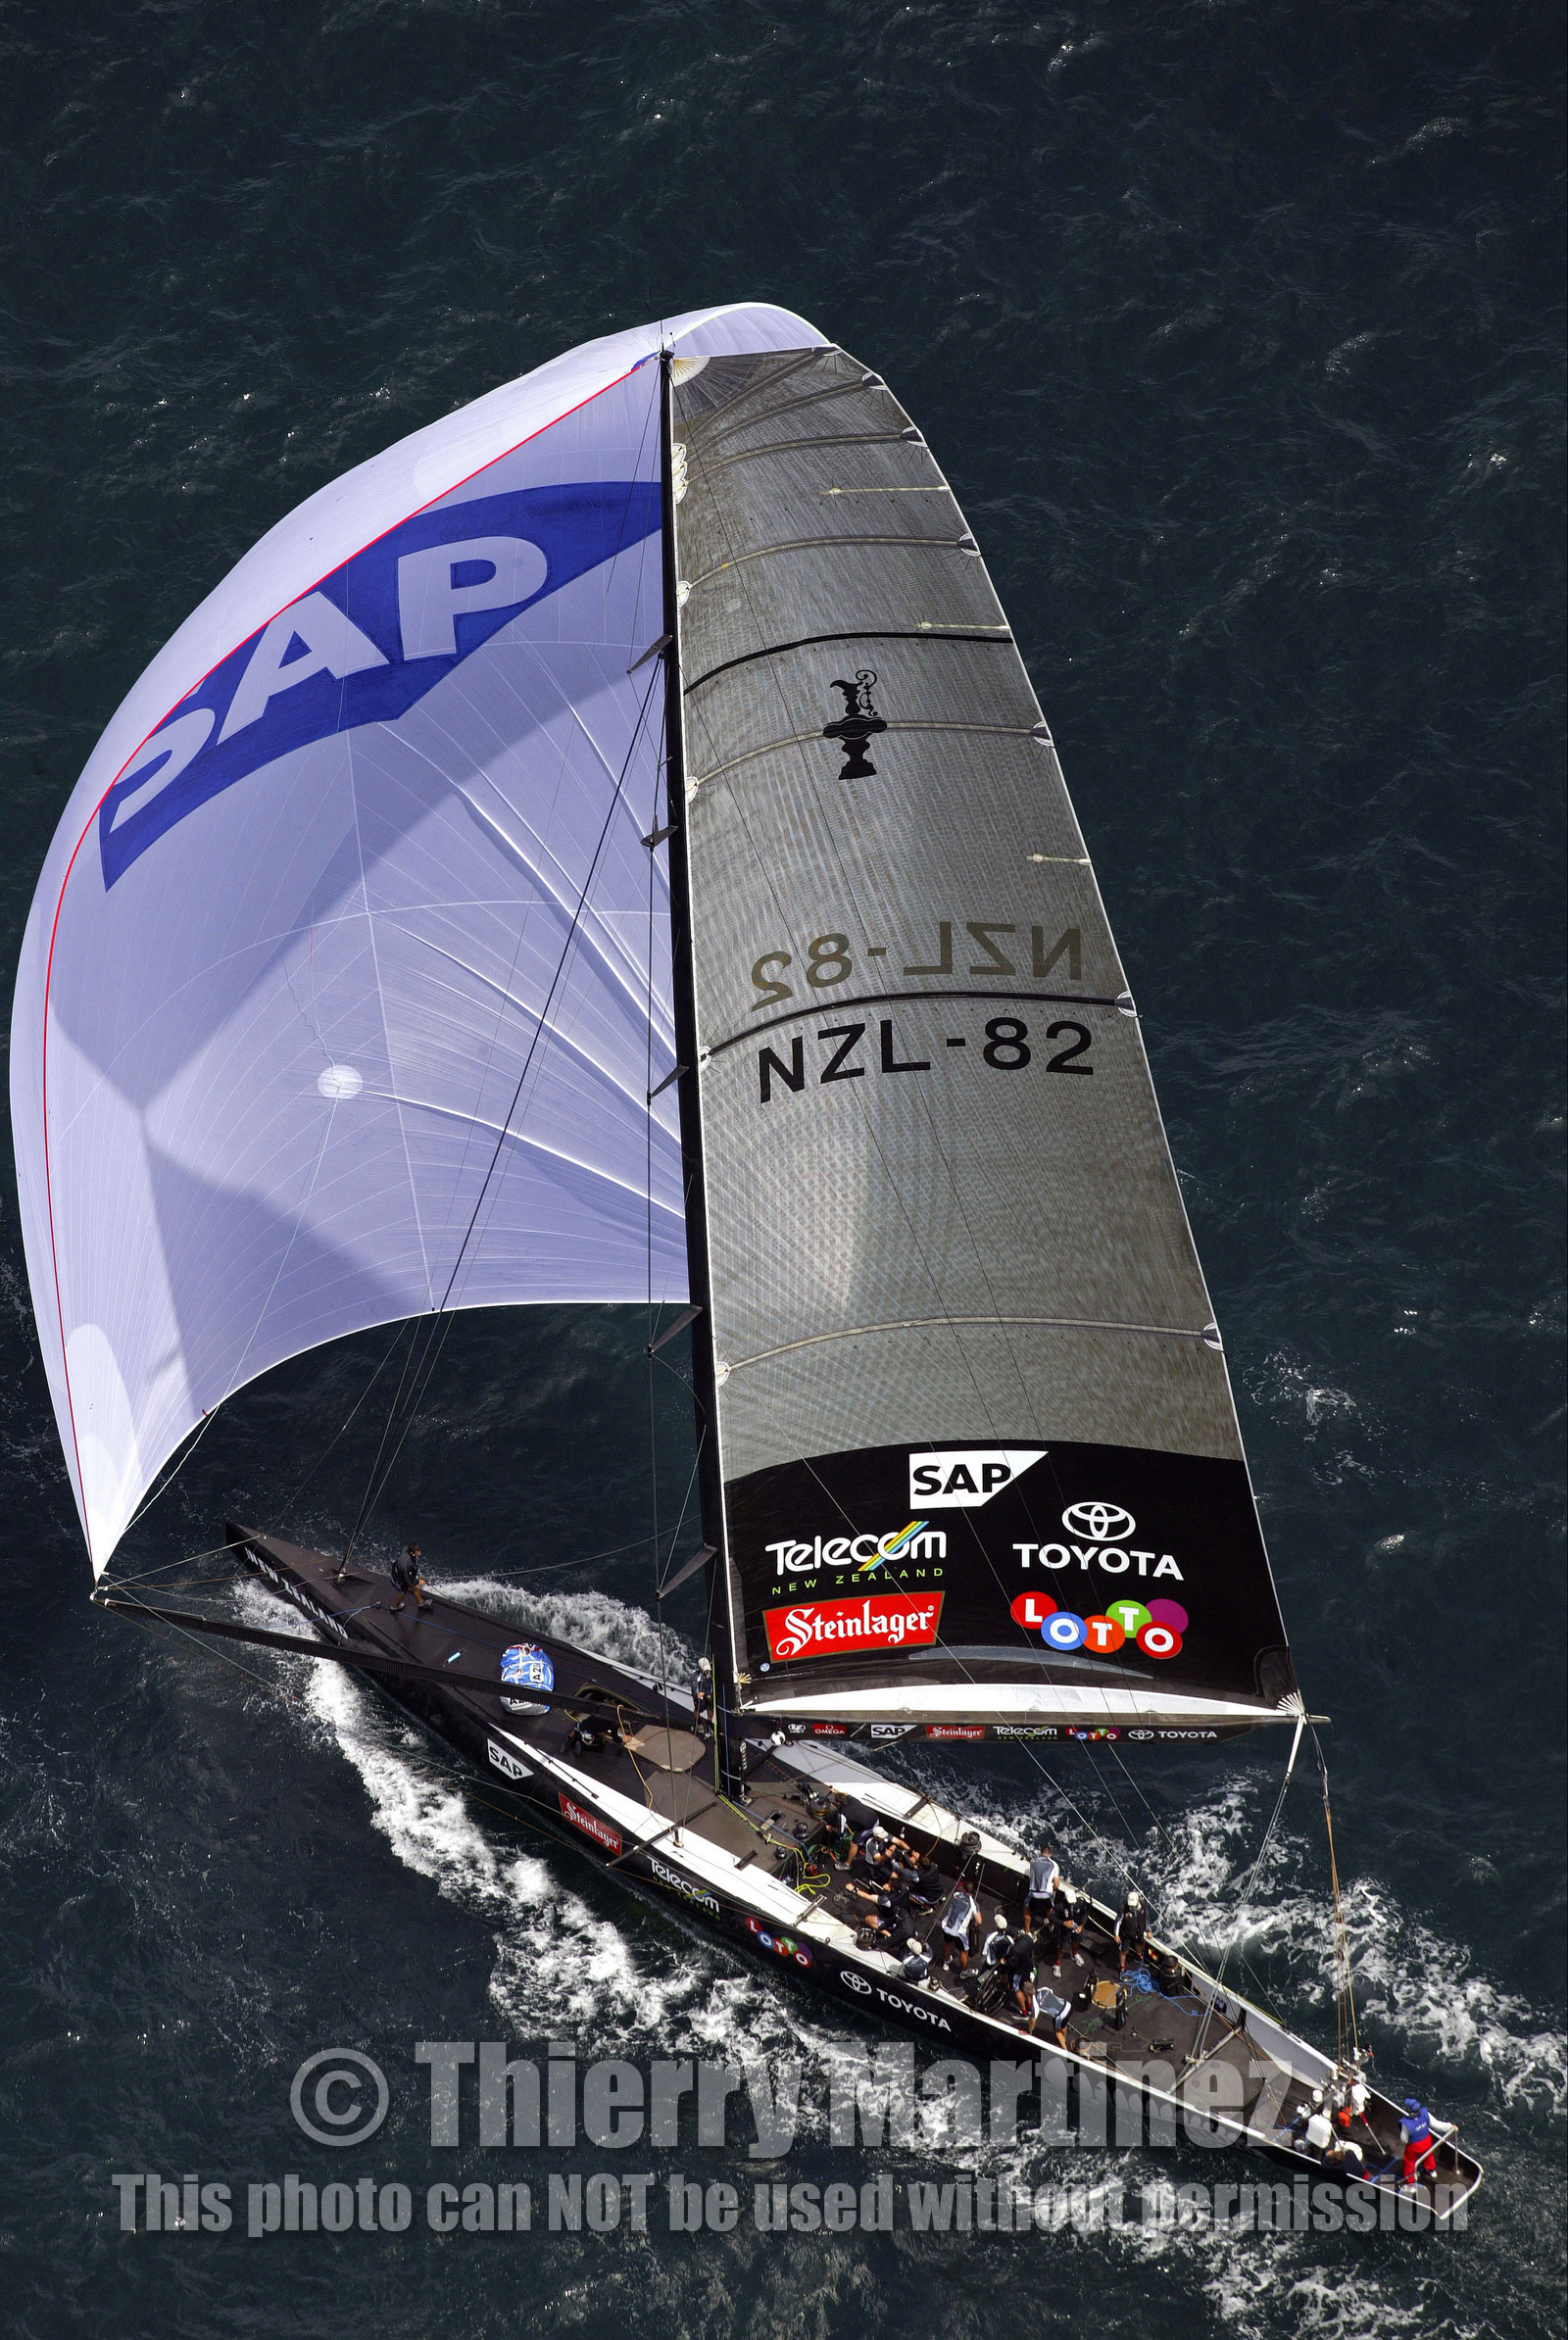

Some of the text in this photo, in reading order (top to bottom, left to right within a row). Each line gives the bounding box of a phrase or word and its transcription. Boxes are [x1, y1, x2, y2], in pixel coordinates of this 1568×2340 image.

[912, 1464, 1011, 1496] SAP
[765, 1529, 947, 1576] Telecom
[1012, 1543, 1185, 1581] TOYOTA
[772, 1568, 944, 1595] NEW ZEALAND
[775, 1599, 934, 1658] Steinlager
[1025, 1597, 1175, 1653] LOTTO
[872, 1727, 906, 1736] SAP
[929, 1727, 982, 1738] Steinlager
[1069, 1729, 1117, 1739] LOTTO
[489, 1746, 523, 1778] SAP
[564, 1801, 619, 1850] Steinlager
[750, 1920, 809, 1966] LOTTO
[875, 1987, 953, 2032] TOYOTA
